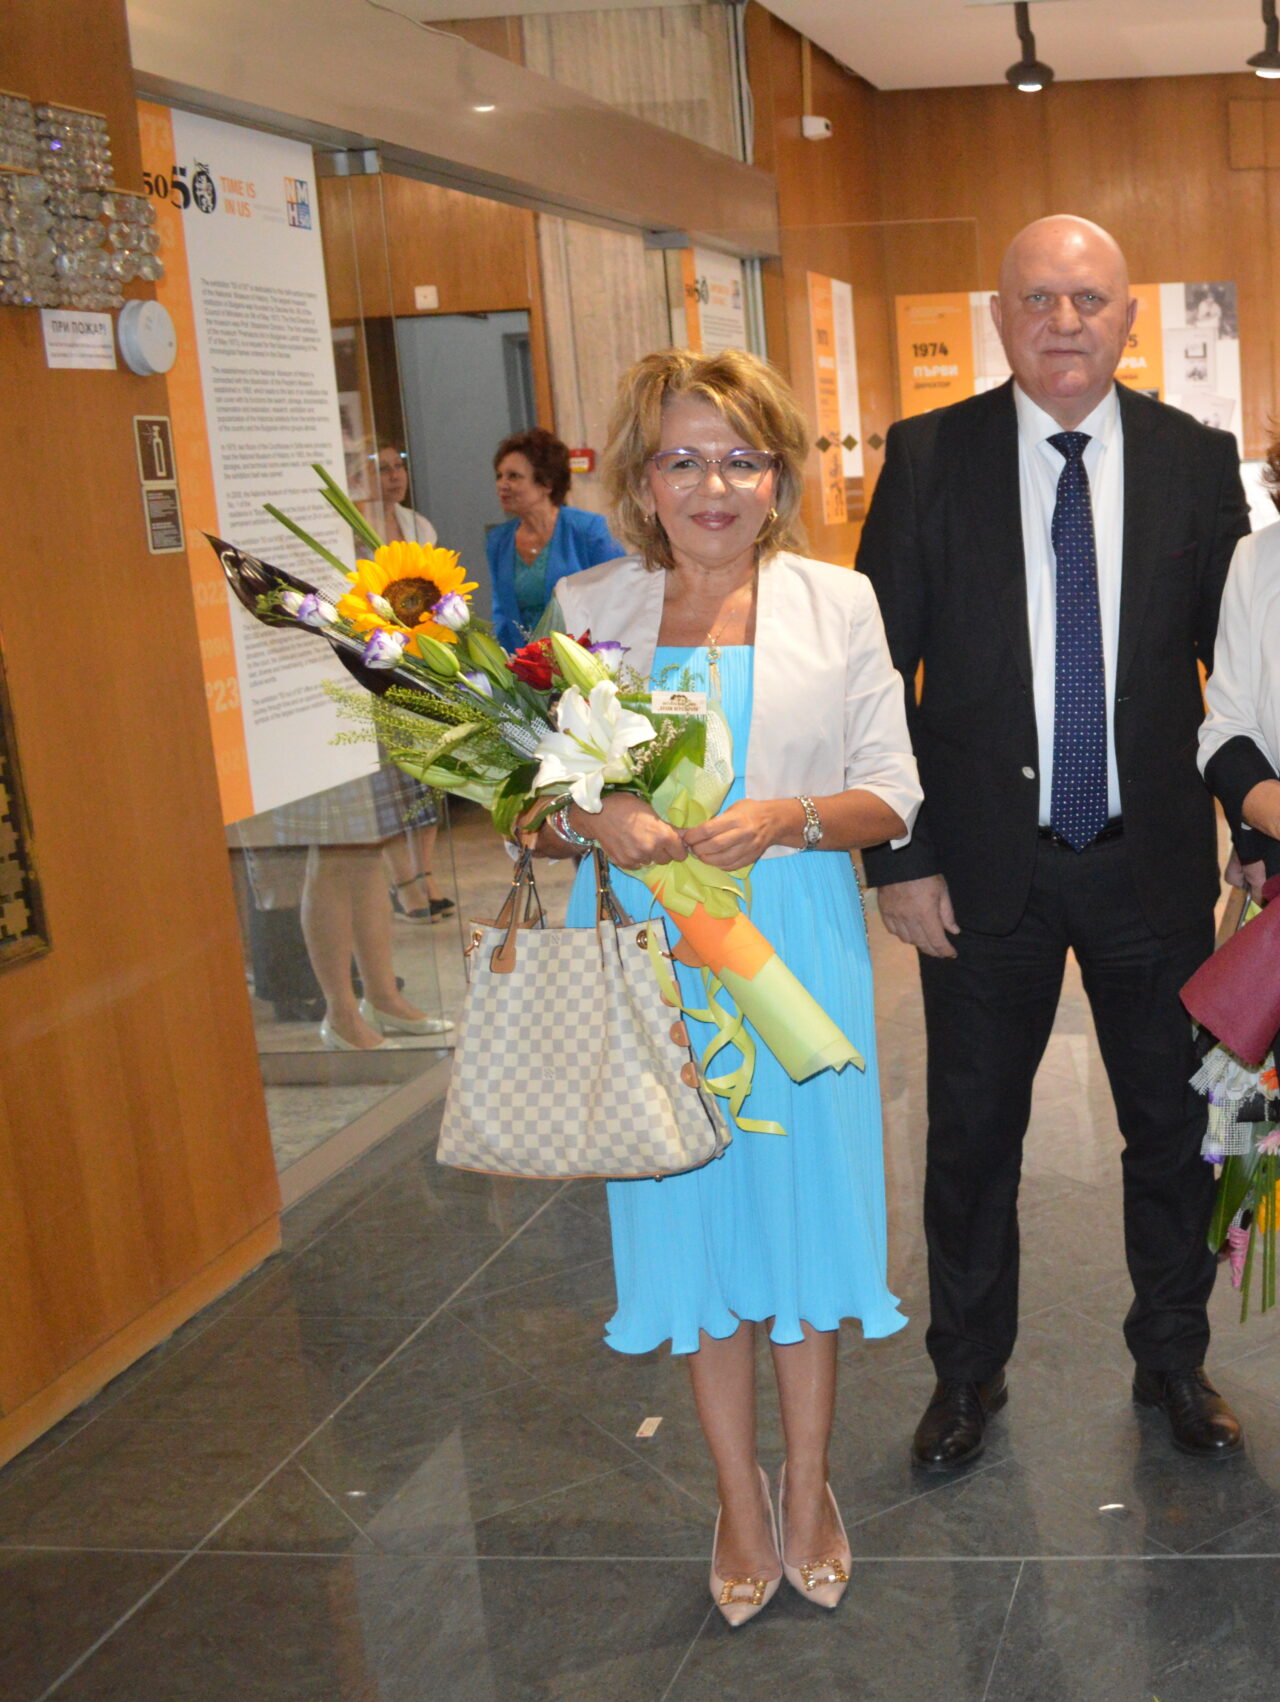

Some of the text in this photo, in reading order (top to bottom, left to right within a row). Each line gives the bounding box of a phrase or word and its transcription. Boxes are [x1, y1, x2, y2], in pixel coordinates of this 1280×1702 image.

[220, 176, 257, 199] TIME IS
[223, 198, 237, 215] IN
[238, 201, 252, 218] US
[50, 320, 70, 334] ПРИ
[912, 342, 949, 358] 1974
[913, 364, 959, 378] ПЪРВИ
